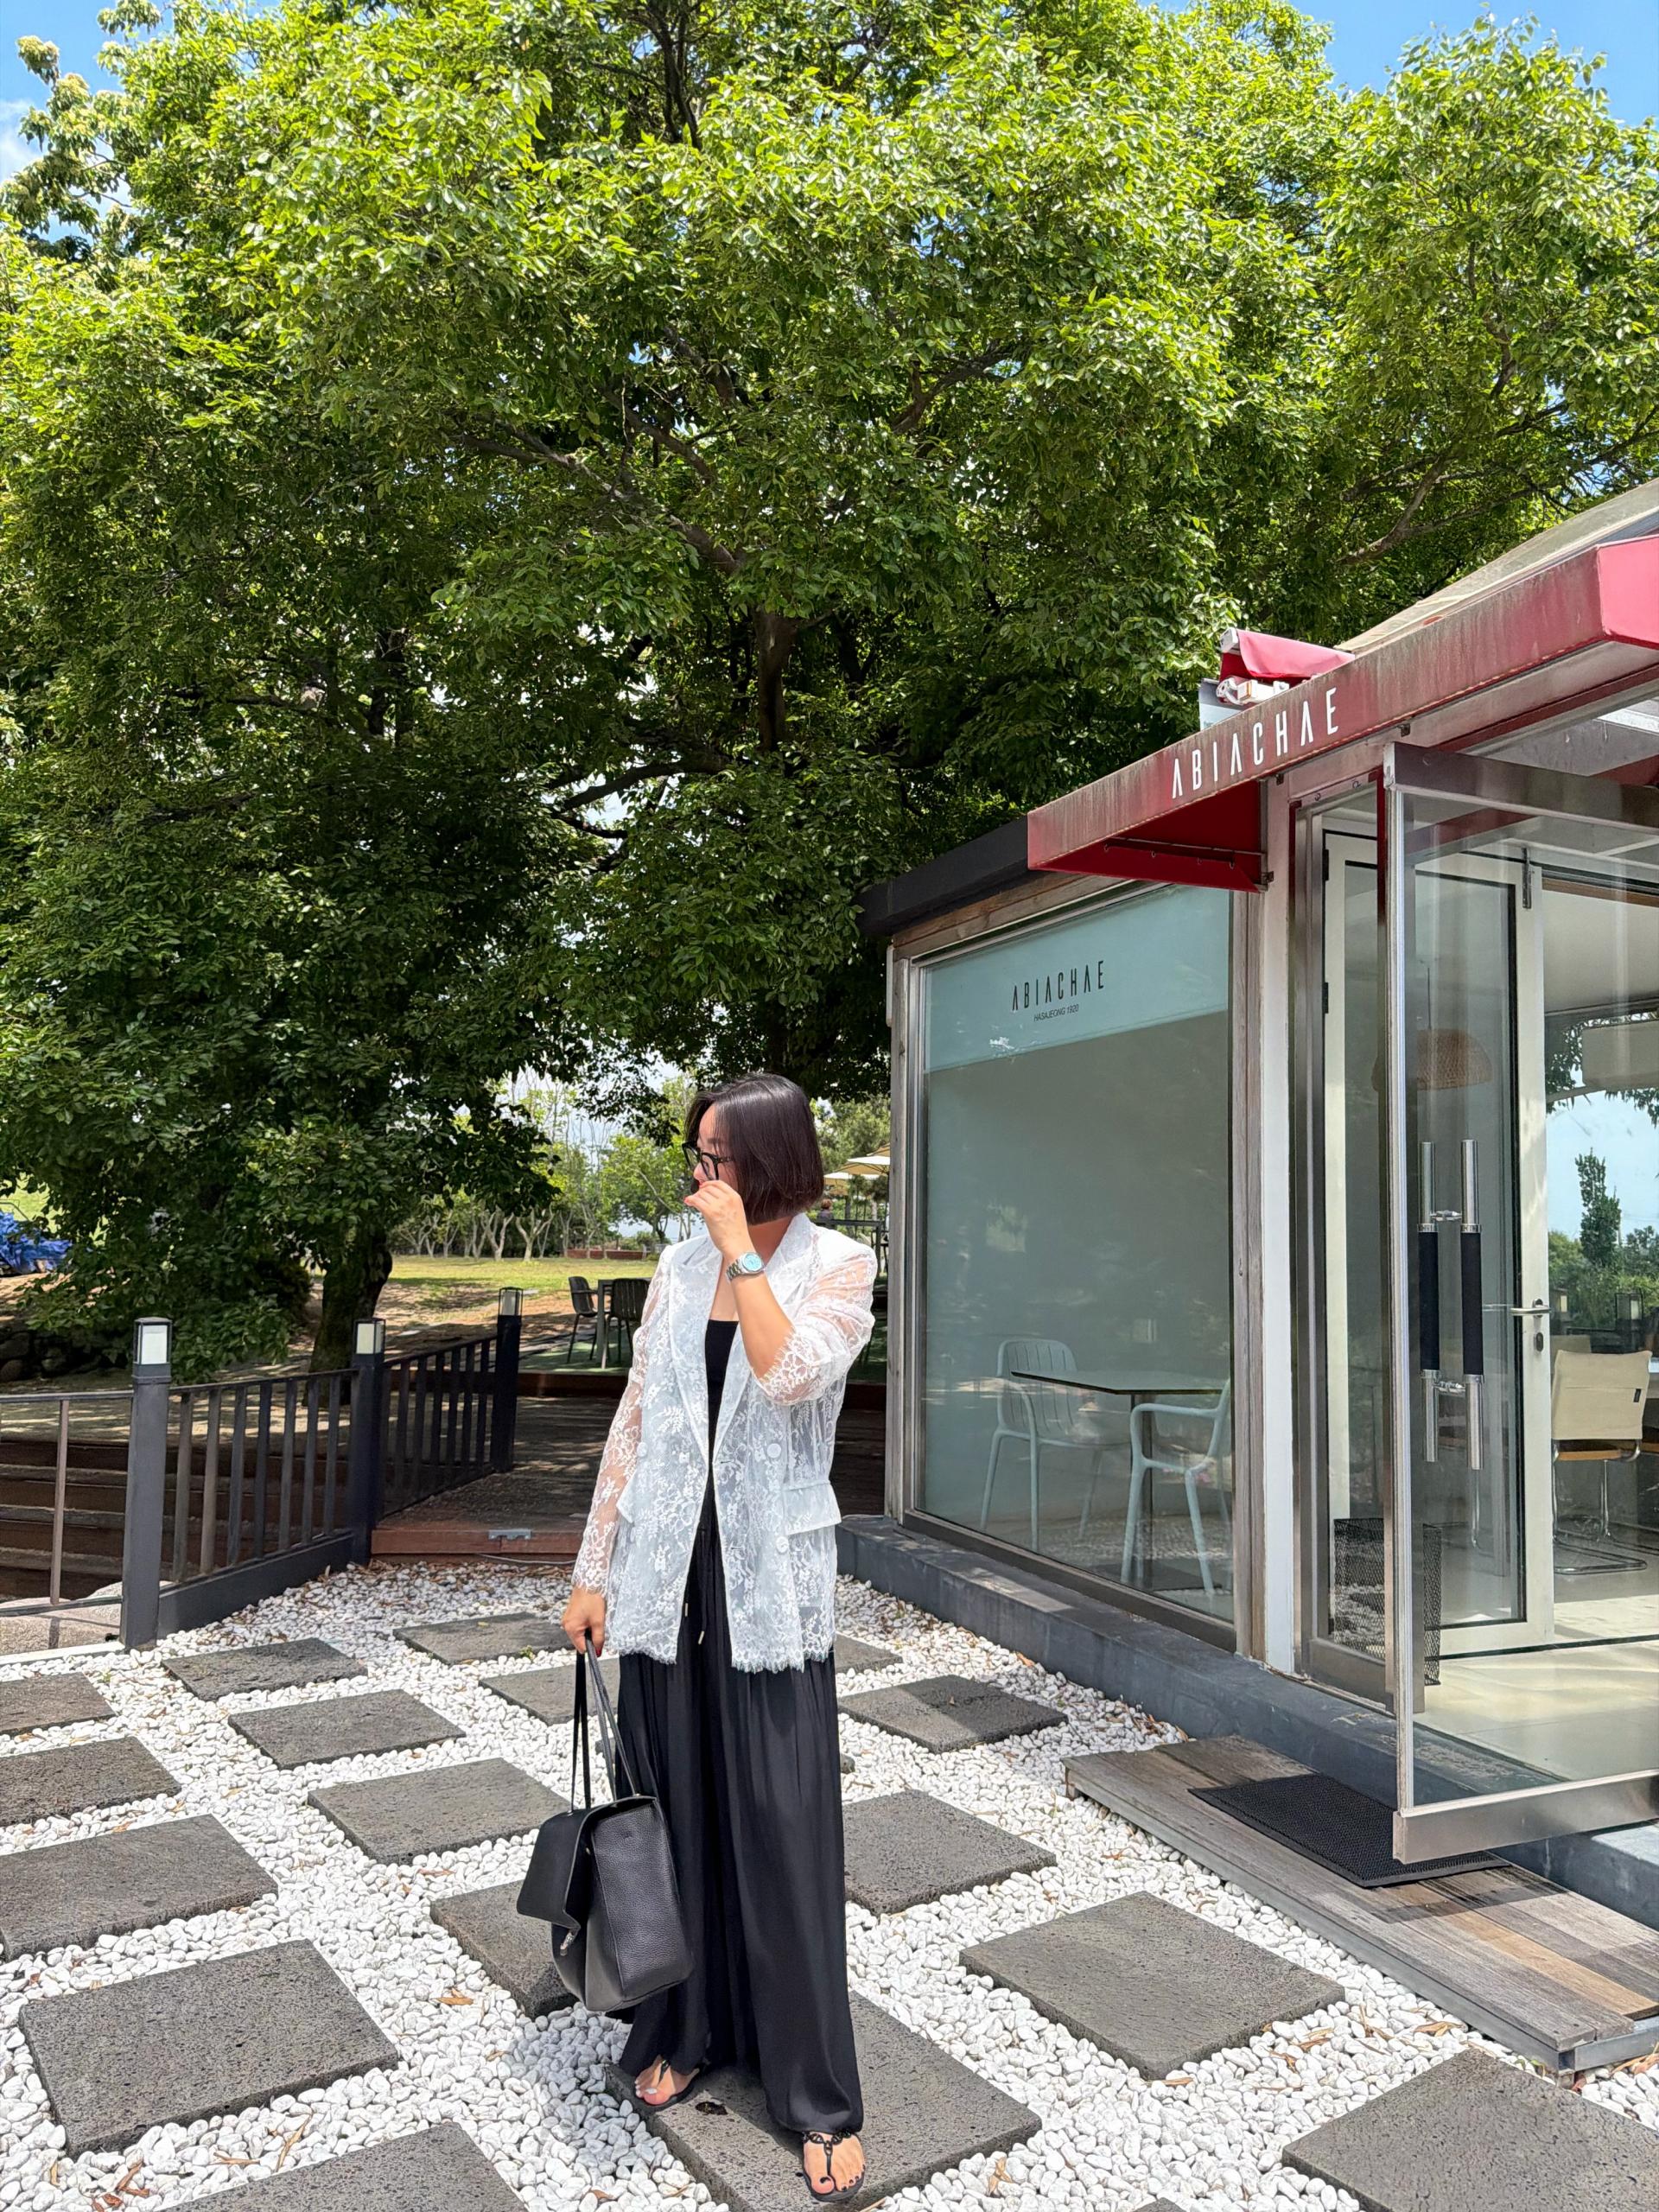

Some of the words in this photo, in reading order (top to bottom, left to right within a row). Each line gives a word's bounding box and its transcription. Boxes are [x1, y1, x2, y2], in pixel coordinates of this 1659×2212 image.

[1172, 687, 1338, 799] ABIACHAE
[1012, 960, 1104, 1012] ABIACHAE
[1066, 1003, 1079, 1014] 1920
